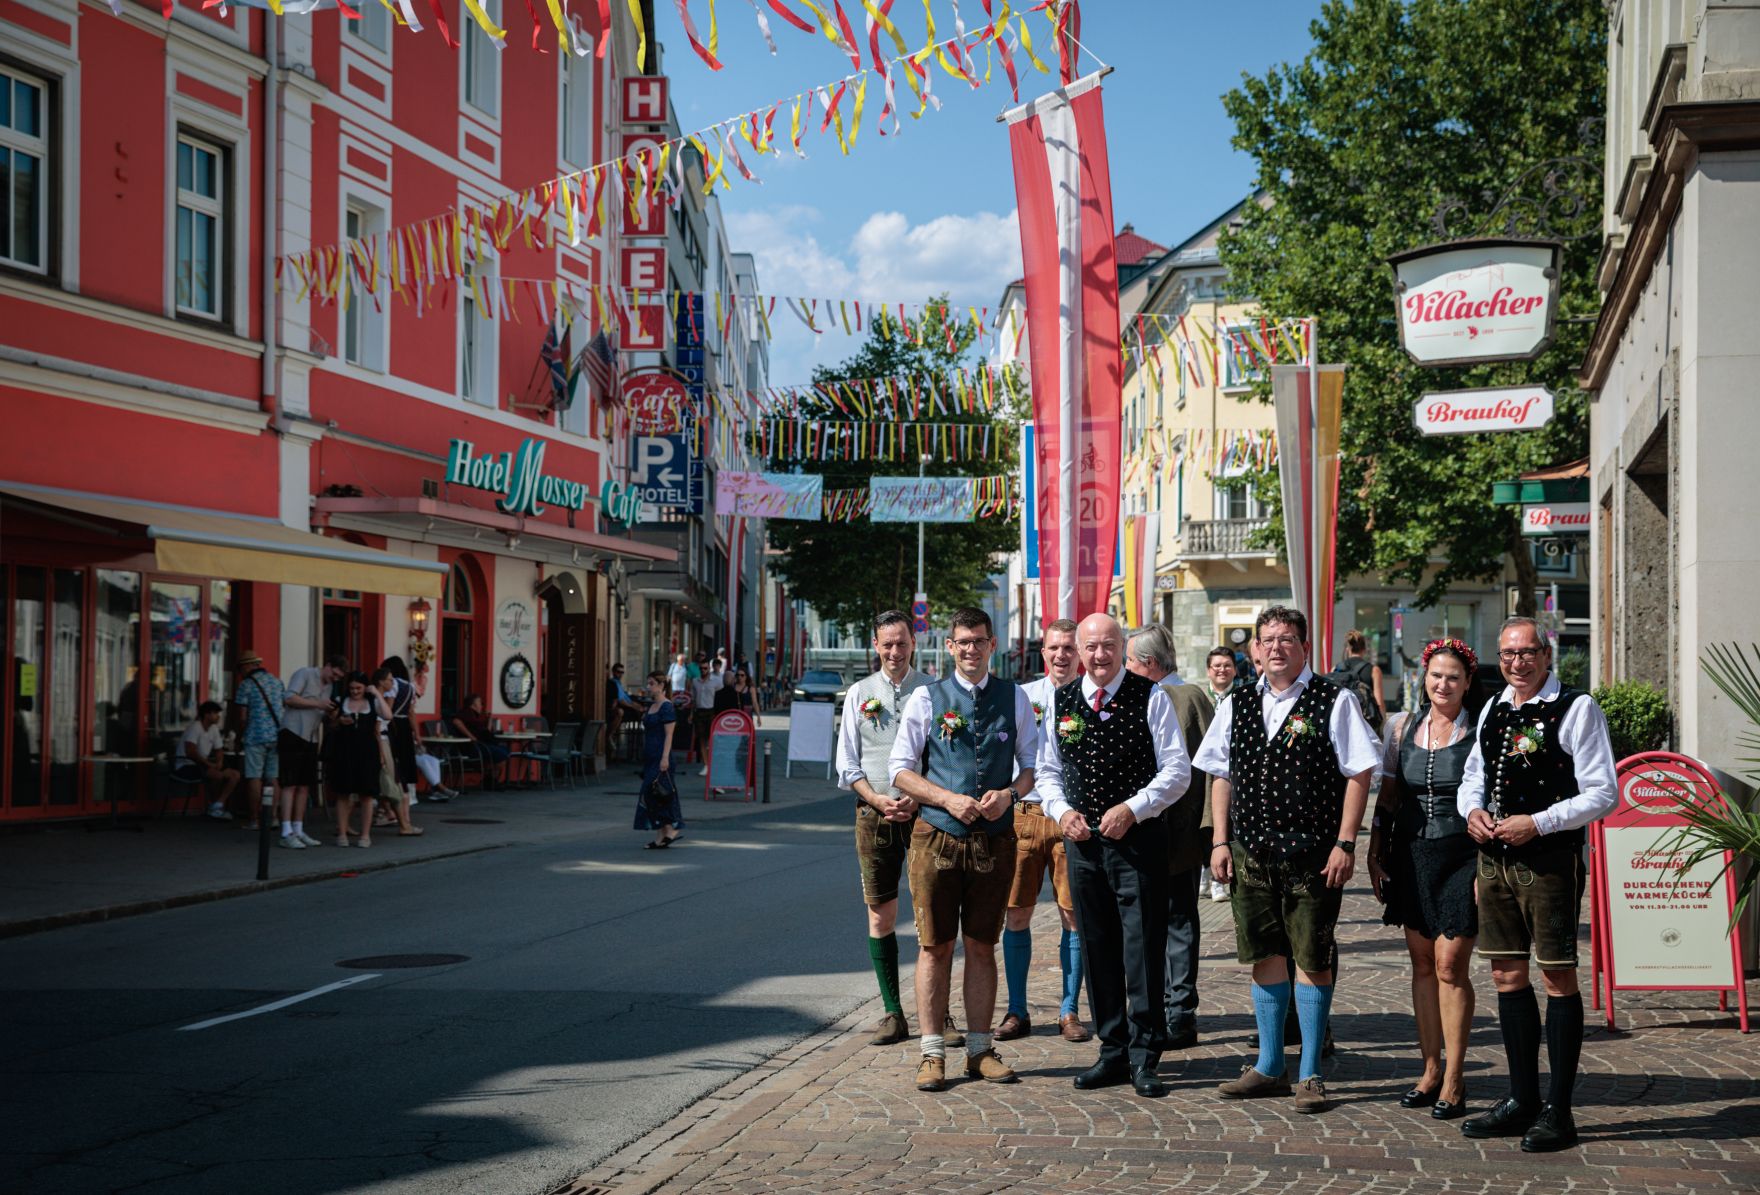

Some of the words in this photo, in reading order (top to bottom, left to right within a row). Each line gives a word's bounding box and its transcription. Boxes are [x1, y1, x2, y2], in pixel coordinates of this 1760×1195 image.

[1406, 287, 1543, 324] Villacher
[1427, 397, 1540, 424] Brauhof
[635, 436, 674, 485] P
[449, 438, 513, 494] Hotel
[501, 438, 589, 516] Mosser
[637, 488, 686, 503] HOTEL
[1038, 540, 1107, 567] Zne
[1631, 857, 1692, 874] Brauho
[1623, 881, 1711, 889] DURCHGEHEND
[1624, 892, 1669, 900] WARME
[1673, 890, 1712, 899] KÜCHE
